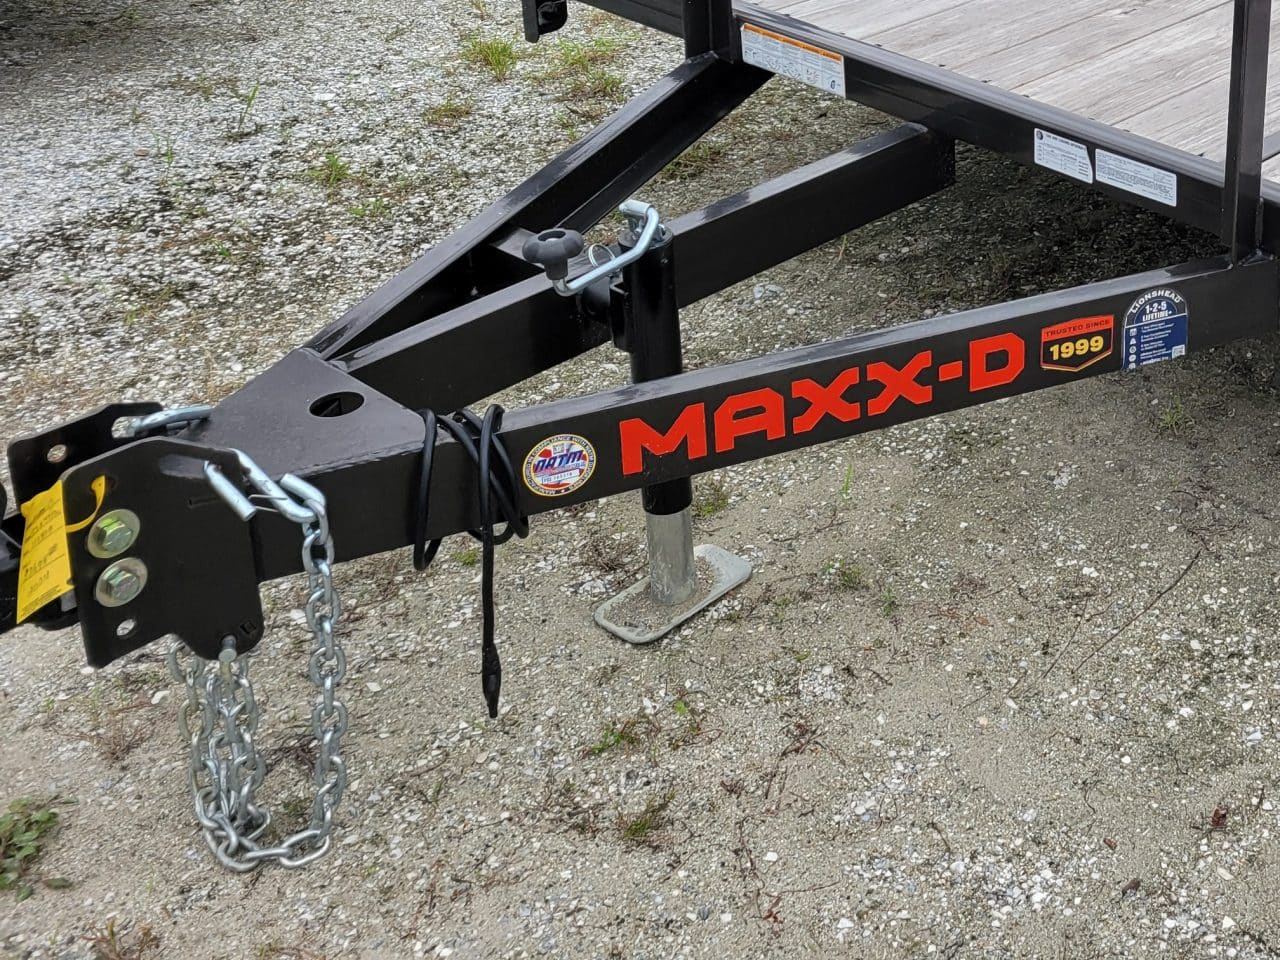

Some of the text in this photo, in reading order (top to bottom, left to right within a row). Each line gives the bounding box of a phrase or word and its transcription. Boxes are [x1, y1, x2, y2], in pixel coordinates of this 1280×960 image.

[1130, 289, 1184, 313] LIONSHEAD
[1046, 319, 1109, 337] TRUSTED SINCE
[1049, 335, 1104, 361] 1999
[619, 332, 1026, 476] MAXX-D
